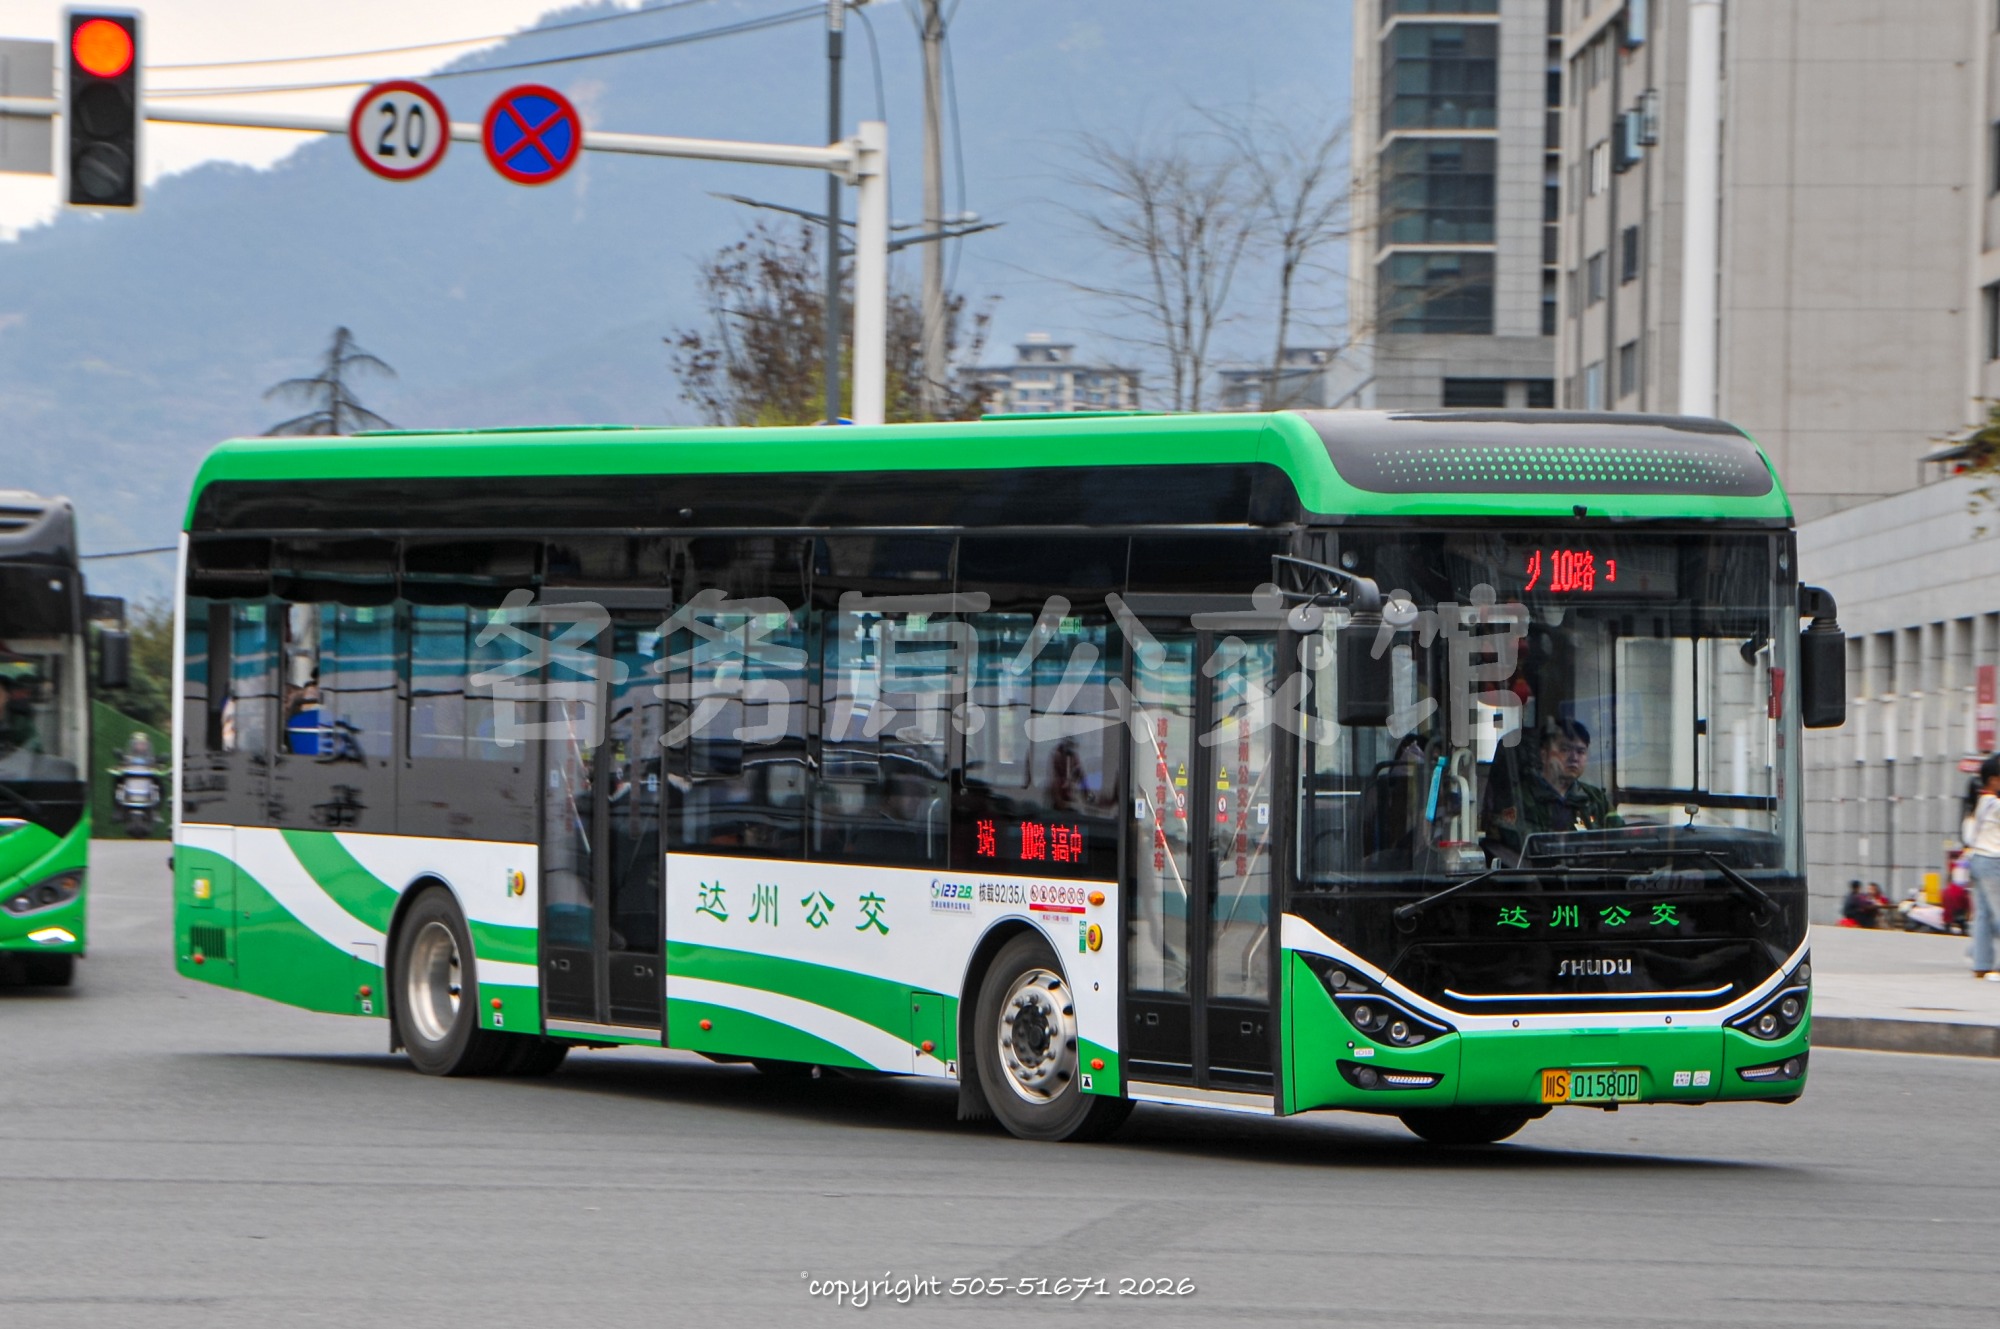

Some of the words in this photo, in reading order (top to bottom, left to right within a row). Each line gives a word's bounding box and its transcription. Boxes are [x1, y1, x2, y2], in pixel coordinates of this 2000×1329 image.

[379, 102, 426, 157] 20
[978, 882, 1027, 905] 核载92/35人
[695, 880, 890, 935] 达州公交
[1497, 903, 1680, 929] 达州公交
[1557, 958, 1632, 976] SHUDU
